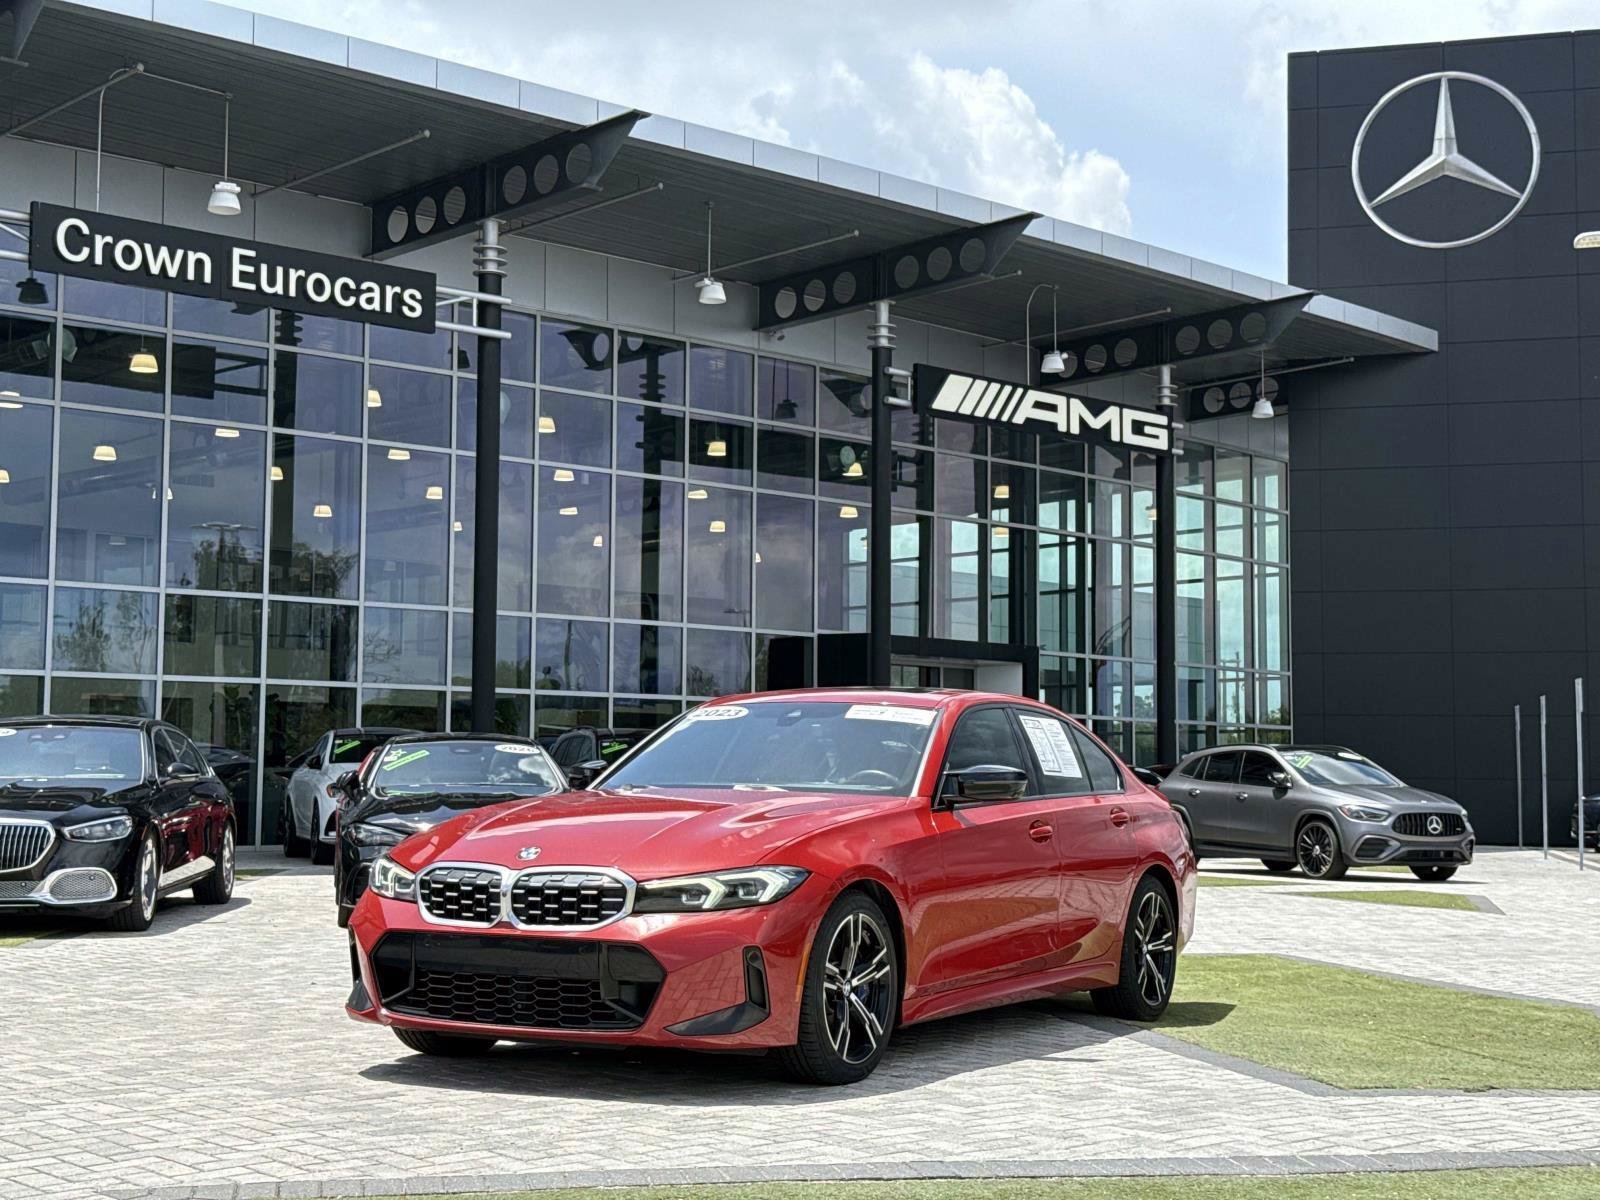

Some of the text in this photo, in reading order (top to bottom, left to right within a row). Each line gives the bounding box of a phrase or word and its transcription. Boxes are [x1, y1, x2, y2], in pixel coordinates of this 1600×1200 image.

[56, 217, 424, 319] Crown Eurocars
[1012, 389, 1169, 451] AMG
[692, 708, 743, 718] 2023
